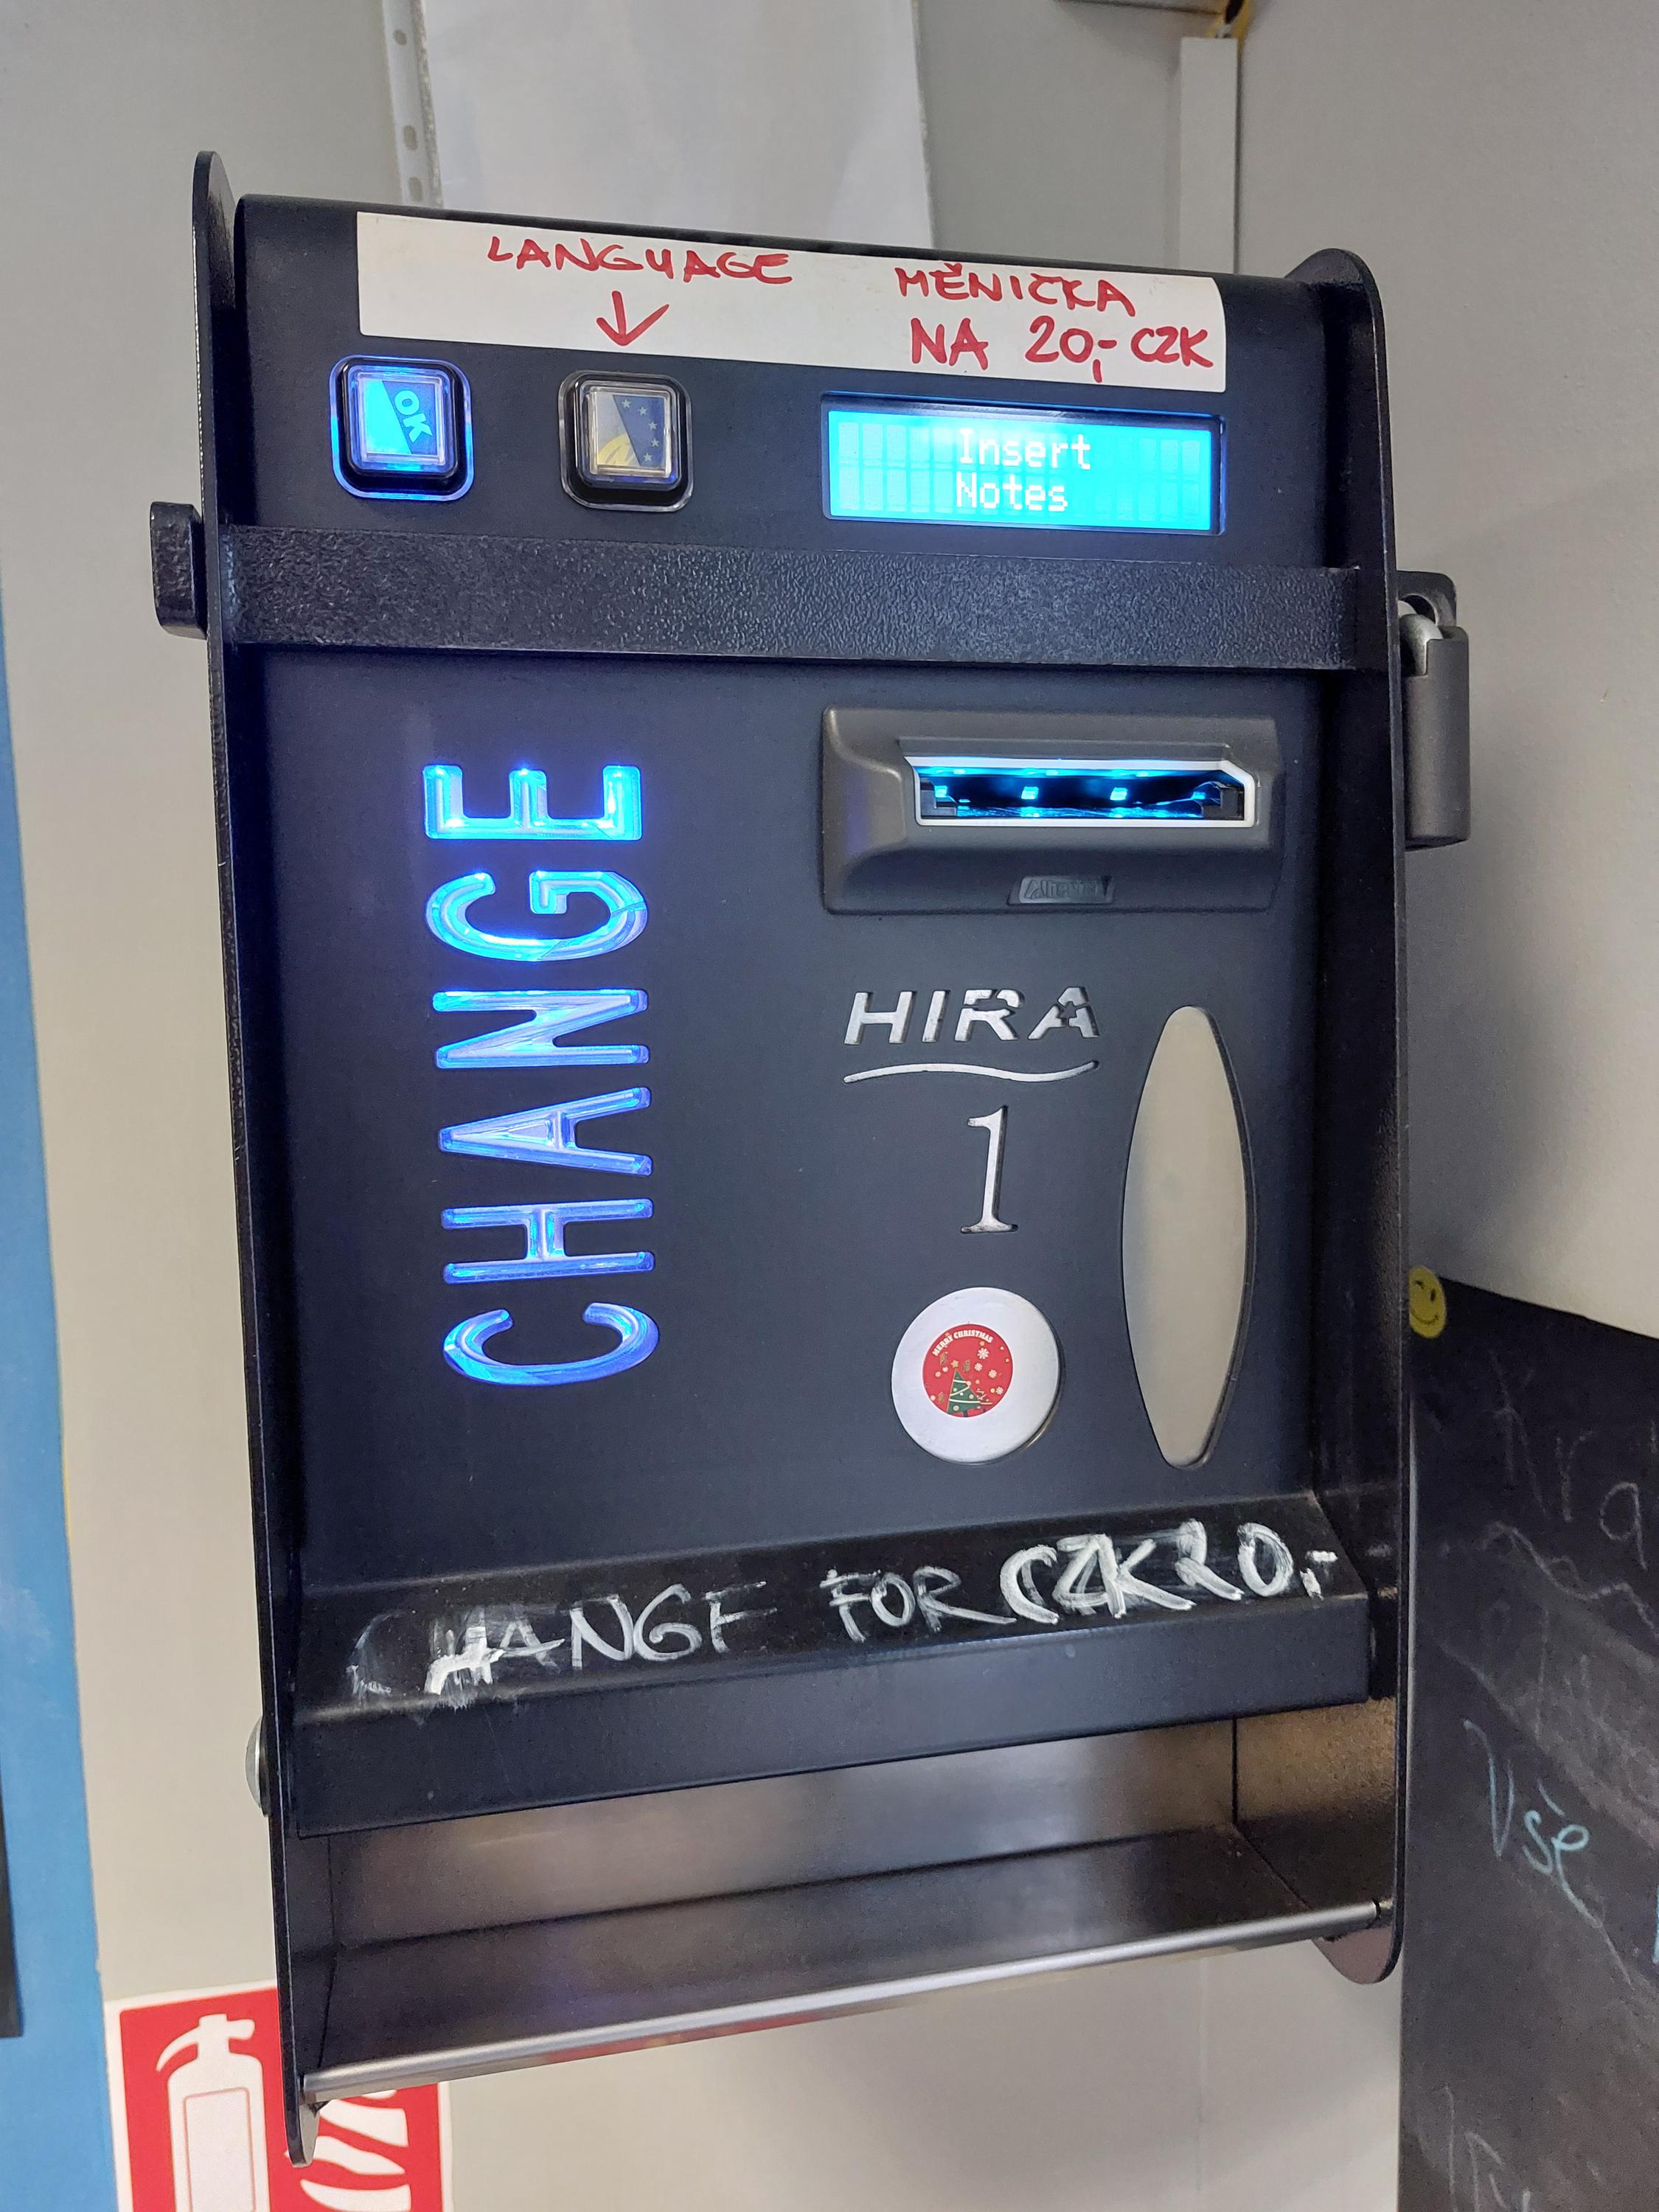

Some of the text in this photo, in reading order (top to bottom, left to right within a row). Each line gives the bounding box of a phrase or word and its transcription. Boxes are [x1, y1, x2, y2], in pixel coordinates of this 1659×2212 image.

[487, 236, 793, 285] LANGUAGE
[911, 318, 989, 370] NA
[394, 390, 434, 443] OK
[959, 428, 1091, 470] Insert
[956, 471, 1068, 512] Notes
[843, 987, 1100, 1045] HIRA
[425, 764, 659, 1385] CHANGE
[961, 1105, 1018, 1234] 1
[932, 1329, 993, 1356] MERRY CHRISTMAS
[820, 1565, 1016, 1643] FOR
